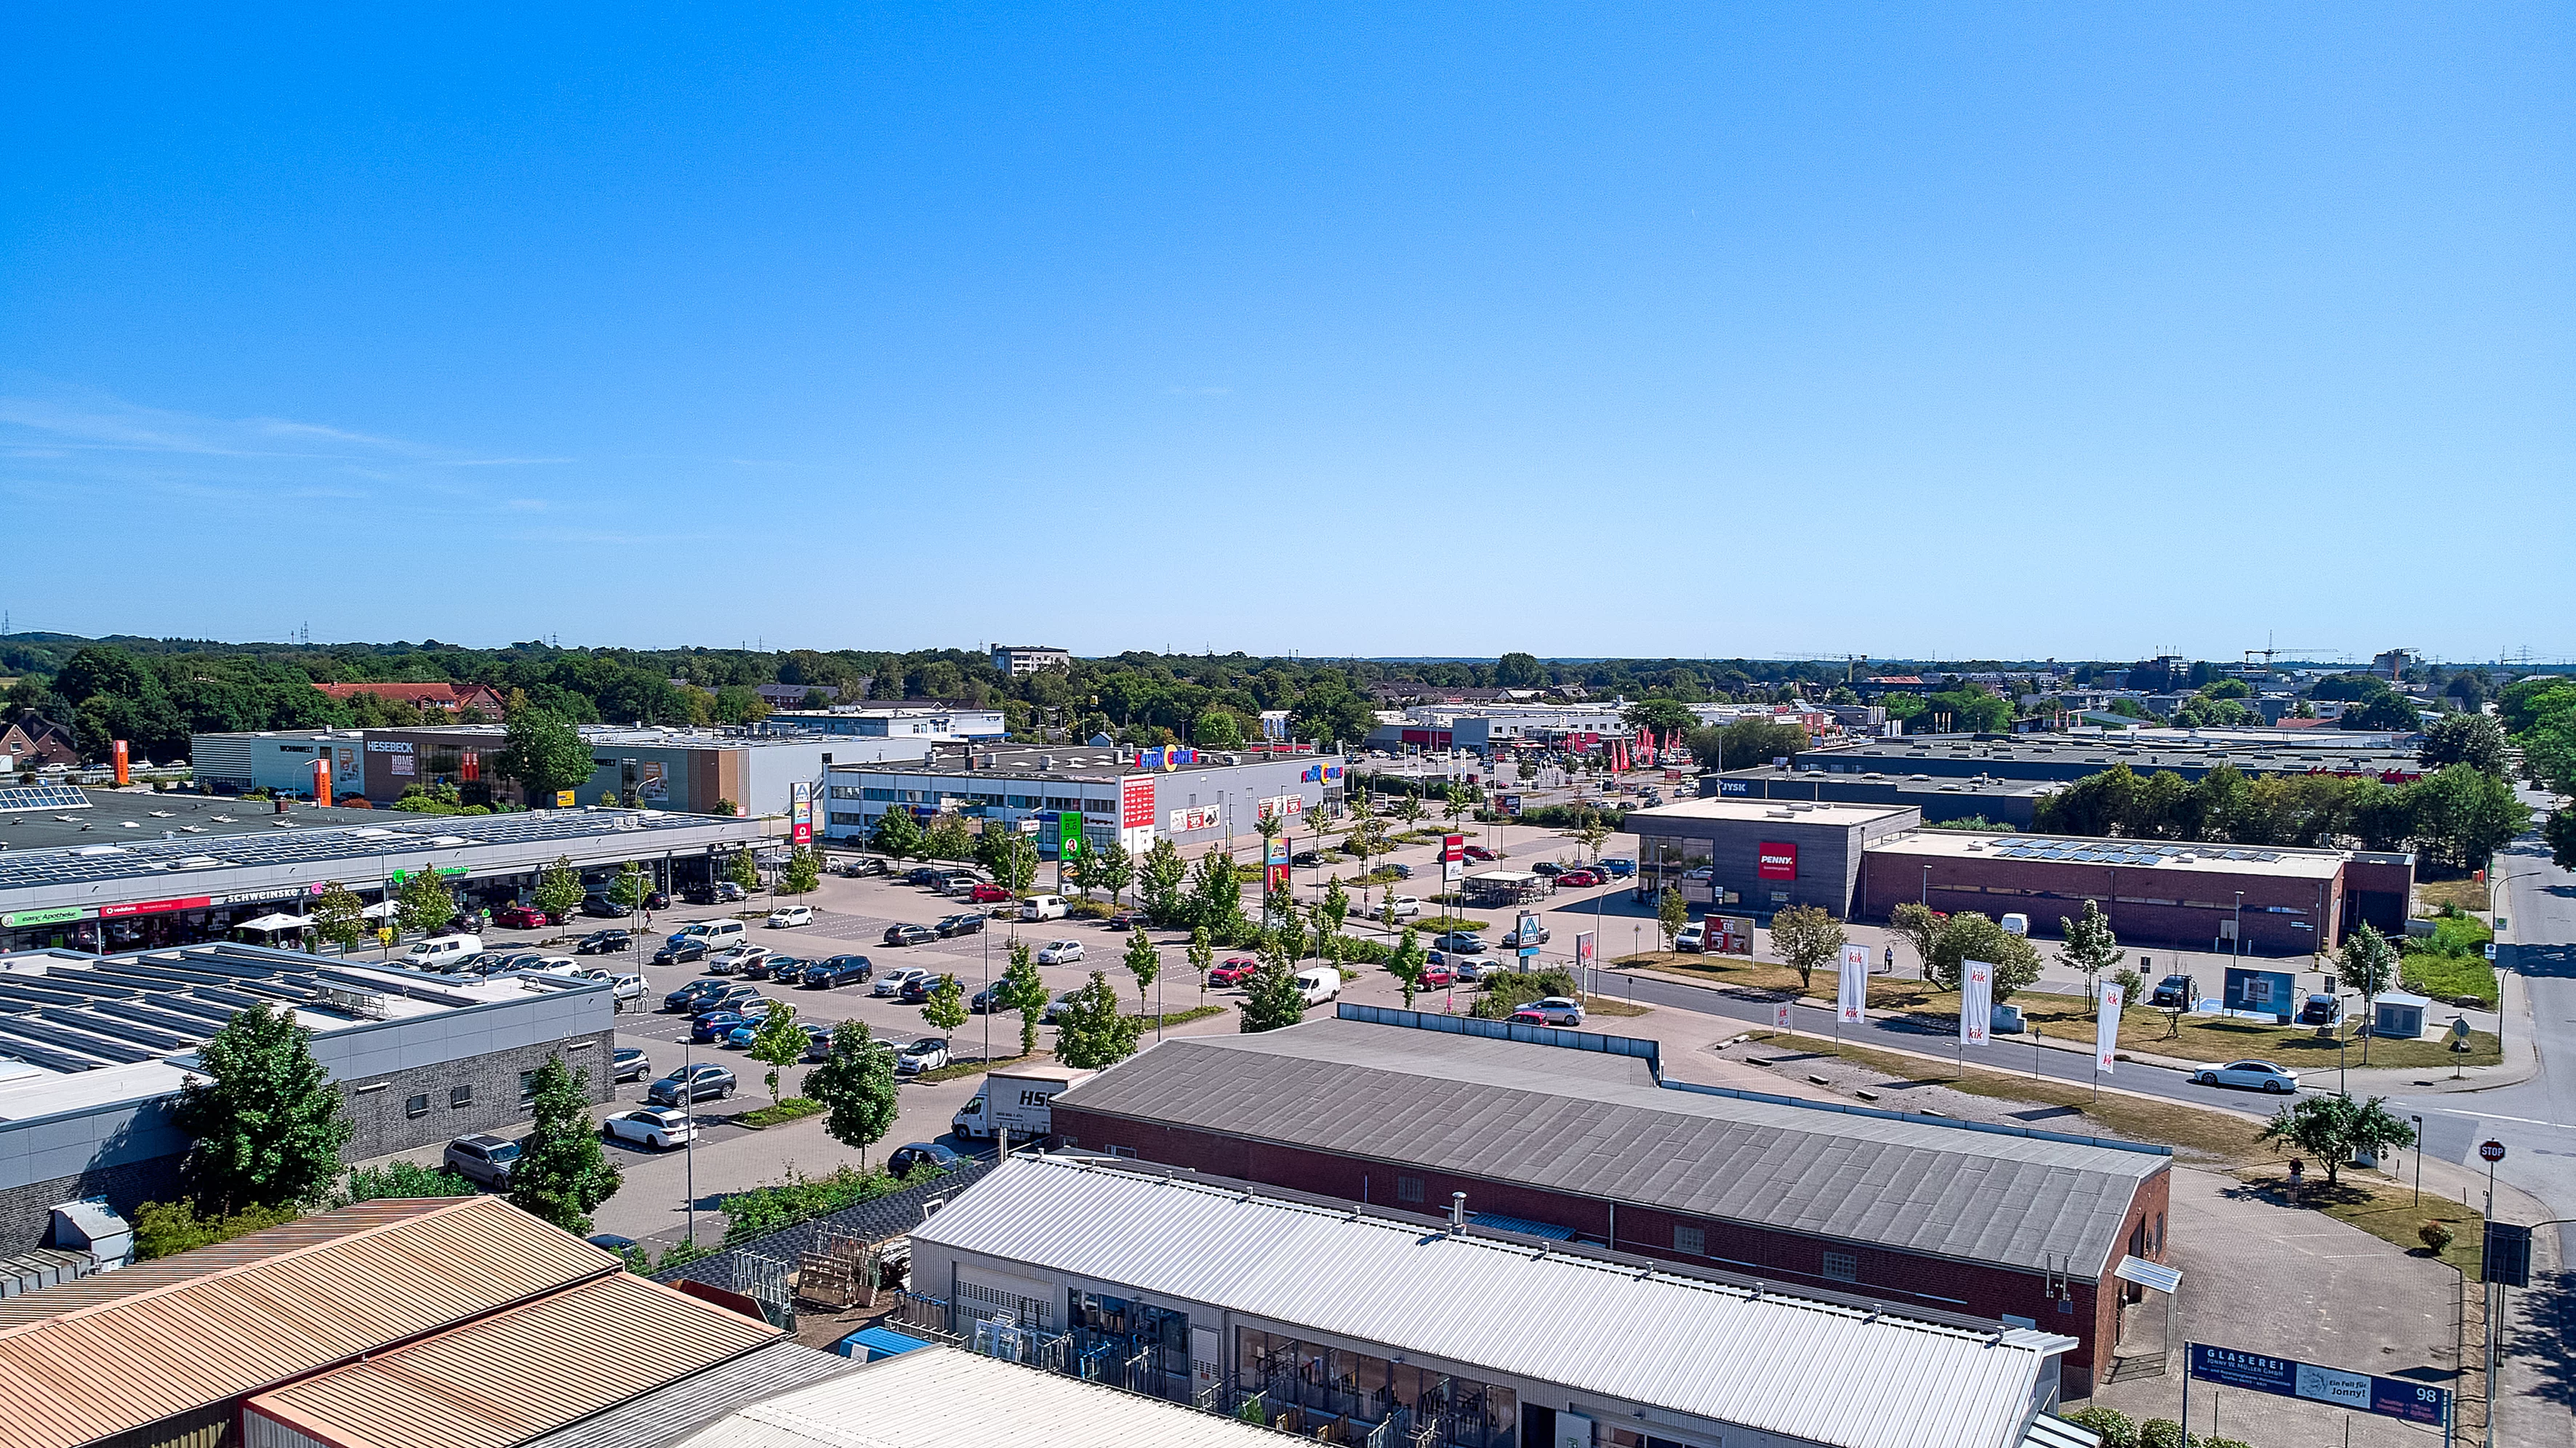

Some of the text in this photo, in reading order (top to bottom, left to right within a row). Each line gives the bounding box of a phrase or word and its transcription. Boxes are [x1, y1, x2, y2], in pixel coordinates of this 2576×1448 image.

[367, 741, 414, 754] HESEBECK
[391, 755, 414, 766] HOME
[1135, 752, 1163, 768] SCHUH
[1722, 783, 1746, 792] JYSK
[1273, 845, 1285, 853] dm
[1849, 952, 1862, 964] kik
[1972, 970, 1986, 983] kik
[1845, 1007, 1858, 1018] kik
[1968, 1028, 1982, 1039] kik
[1019, 1090, 1054, 1107] HS
[2481, 1146, 2503, 1157] STOP
[2207, 1349, 2284, 1370] GLASEREI
[2207, 1357, 2226, 1366] JONNY
[2237, 1363, 2262, 1373] MÜLLER
[2332, 1388, 2366, 1398] Jonny!
[2416, 1388, 2436, 1402] 98
